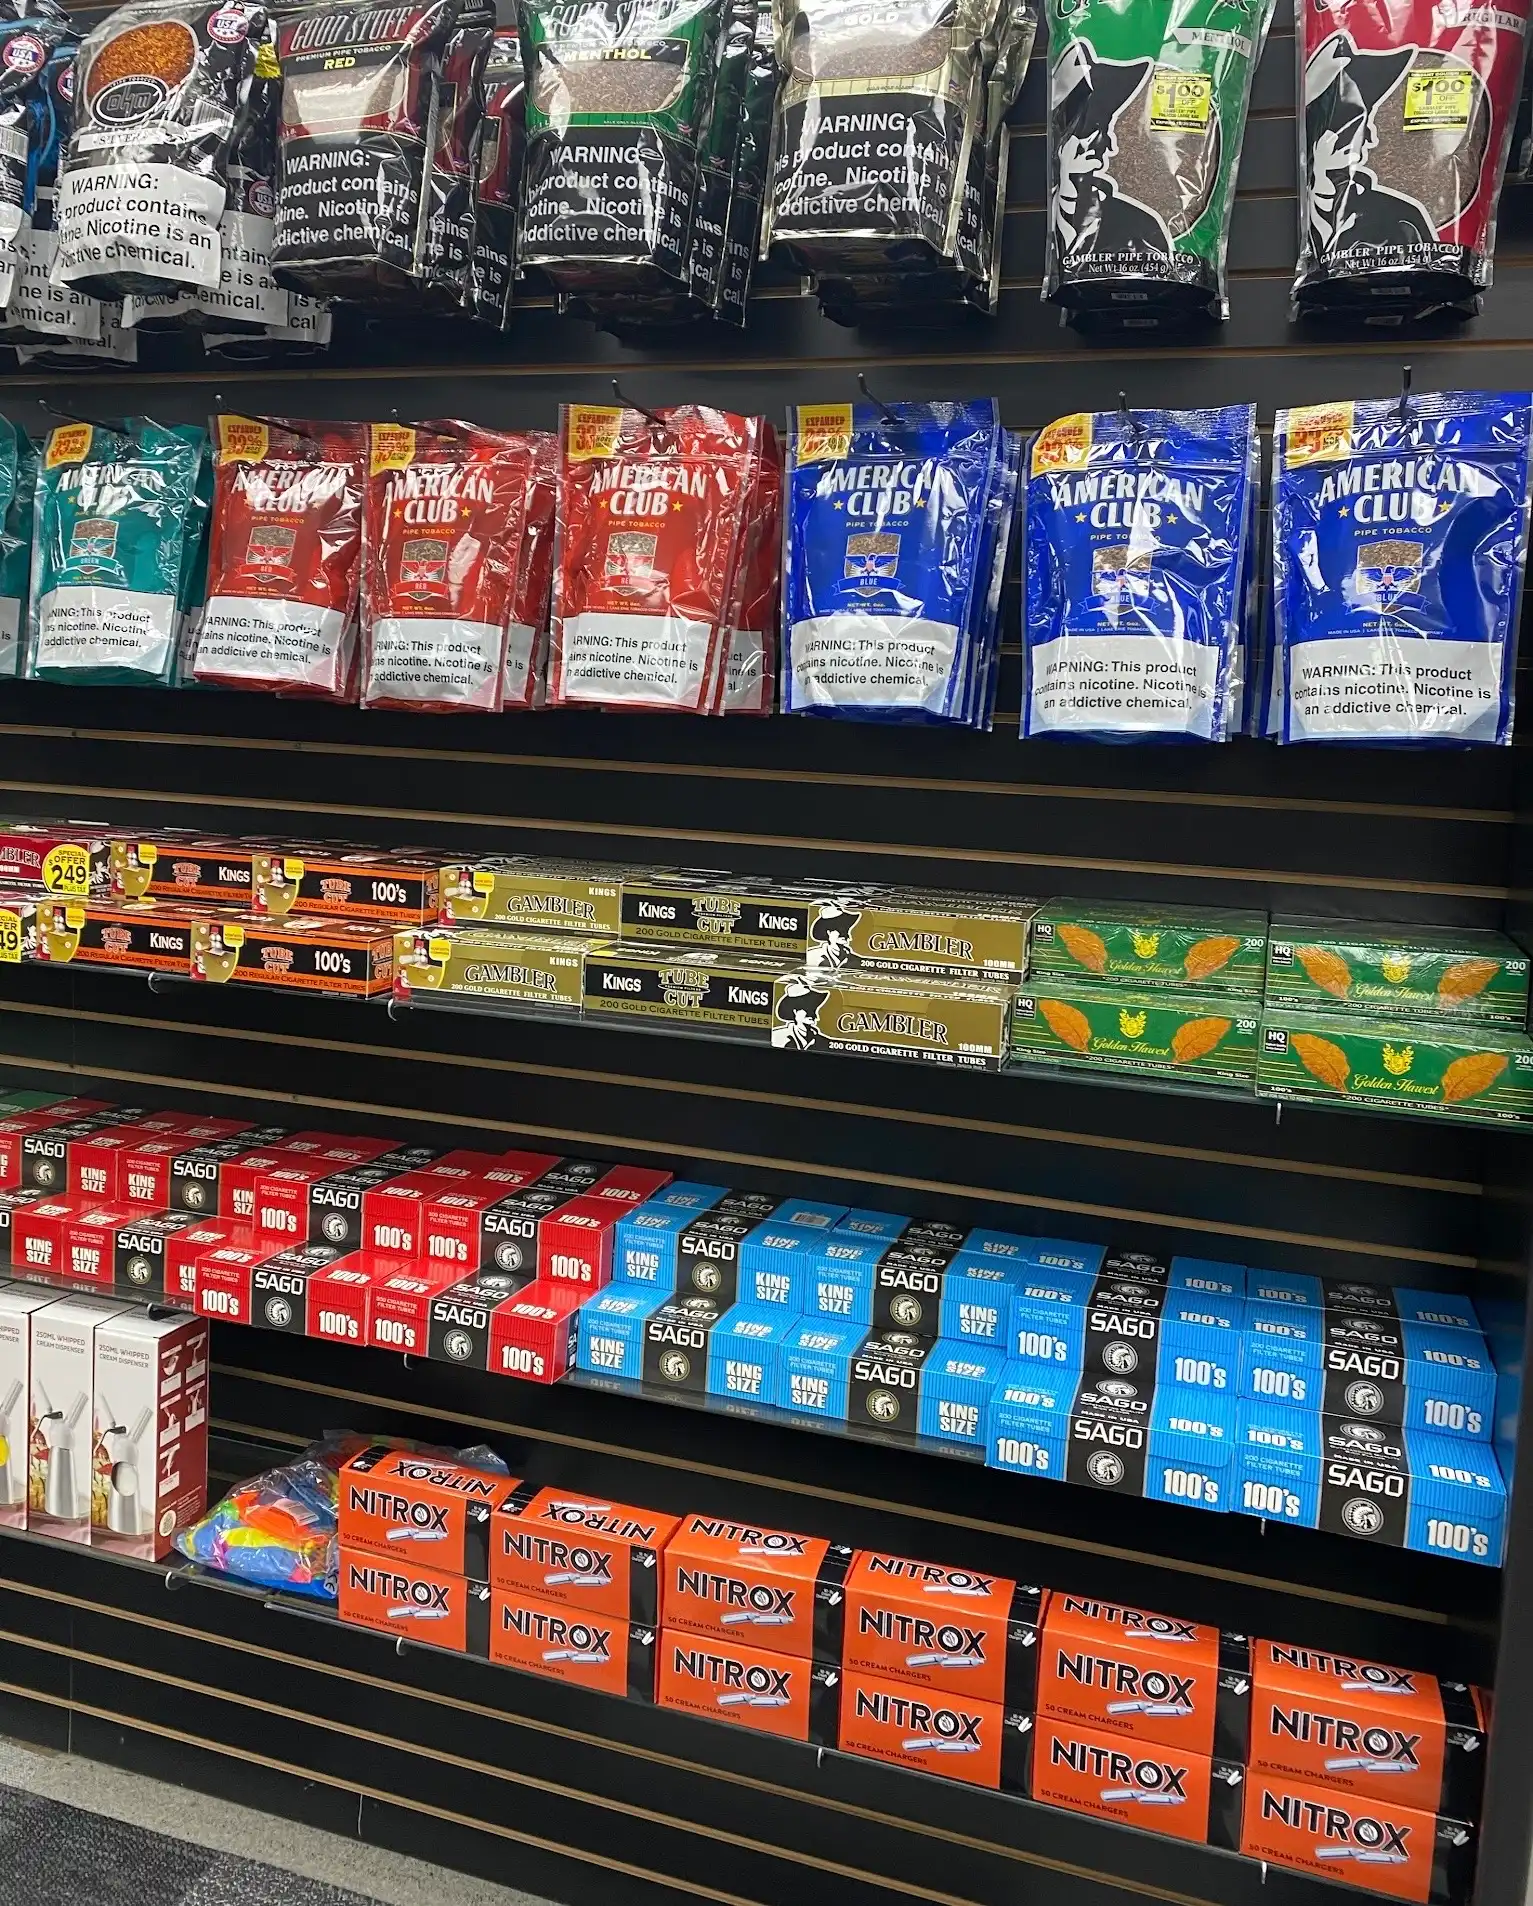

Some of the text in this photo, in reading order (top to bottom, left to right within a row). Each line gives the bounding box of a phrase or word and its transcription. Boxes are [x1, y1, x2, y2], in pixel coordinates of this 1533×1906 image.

[215, 18, 239, 30] USA
[290, 6, 413, 53] GOOD STUFF
[295, 44, 392, 62] PREMIUM PIPE TOBACCO
[564, 48, 652, 61] MENTHOL
[323, 56, 356, 70] RED
[286, 149, 371, 175] WARNING:
[792, 141, 870, 169] product
[71, 174, 159, 195] WARNING:
[281, 177, 418, 205] product contains
[539, 173, 608, 193] product
[845, 167, 947, 198] Nicotine is
[64, 196, 207, 225] product contains
[318, 200, 390, 217] Nicotine
[397, 208, 410, 225] is
[669, 209, 682, 228] is
[86, 219, 161, 239] Nicotine
[166, 226, 184, 241] is
[189, 232, 212, 250] an
[333, 224, 413, 252] chemical.
[105, 243, 196, 270] chemical.
[1117, 251, 1143, 263] PIPE
[1145, 251, 1194, 265] TOBACCO
[1376, 244, 1403, 255] PIPE
[1406, 242, 1461, 254] TOBACCO
[1052, 472, 1204, 511] AMERICAN
[1317, 457, 1479, 508] AMERICAN
[404, 500, 458, 524] CLUB
[608, 490, 669, 516] CLUB
[422, 528, 456, 536] TOBACCO
[608, 520, 665, 528] PIPE TOBACCO
[1354, 526, 1432, 536] PIPE TOBACCO
[860, 577, 878, 586] BLUE
[252, 618, 274, 631] This
[226, 632, 271, 645] nicotine.
[412, 640, 434, 652] This
[615, 637, 687, 653] This product
[859, 640, 884, 651] This
[388, 657, 432, 668] nicotine.
[589, 652, 698, 671] nicotine. Nicotine is
[830, 655, 882, 668] nicotine.
[1111, 660, 1141, 673] This
[423, 671, 474, 685] chemical.
[575, 666, 678, 684] addictive chemical.
[815, 672, 929, 686] addictive chemical.
[1302, 664, 1472, 682] WARNING: product
[1079, 678, 1139, 690] nicotine.
[1345, 683, 1491, 699] nicotine. Nicotine is
[1044, 695, 1122, 709] an addictive
[1305, 702, 1319, 715] an
[54, 855, 85, 865] OFFER
[59, 849, 86, 858] SPECIAL
[320, 878, 352, 892] TUBE
[371, 881, 407, 904] 100's
[588, 887, 617, 897] KINGS
[323, 892, 349, 904] CUT
[507, 894, 596, 921] GAMBLER
[692, 896, 741, 915] TUBE
[309, 902, 339, 911] REGULAR
[340, 904, 374, 915] CIGARETTE
[376, 908, 398, 917] FILTER
[638, 901, 676, 920] KINGS
[507, 914, 524, 922] GOLD
[525, 916, 561, 926] CIGARETTE
[563, 920, 586, 928] FILTER
[590, 922, 611, 930] TUBES
[697, 917, 735, 934] CUT
[1037, 925, 1052, 933] HQ
[150, 932, 184, 951] KINGS
[635, 927, 798, 949] 200 GOLD CIGARETTE FILTER TUBES
[314, 950, 351, 973] 100's
[983, 958, 1015, 969] 100MM
[1505, 961, 1526, 971] 200
[464, 963, 557, 993] GAMBLER
[1018, 999, 1033, 1008] HQ
[837, 1012, 949, 1045] GAMBLER
[1236, 1019, 1256, 1030] 200
[1091, 1036, 1128, 1053] Golden
[1267, 1031, 1286, 1041] HQ
[1351, 1073, 1393, 1090] Golden
[24, 1138, 65, 1159] SAGO
[80, 1166, 107, 1181] KING
[173, 1159, 217, 1181] SAGO
[81, 1179, 105, 1194] SIZE
[311, 1187, 359, 1210] SAGO
[260, 1207, 297, 1233] 100's
[484, 1214, 535, 1239] SAGO
[681, 1236, 735, 1261] SAGO
[551, 1254, 592, 1282] 100's
[626, 1250, 659, 1267] KING
[626, 1263, 657, 1281] SIZE
[880, 1268, 939, 1294] SAGO
[201, 1288, 239, 1316] 100's
[433, 1303, 487, 1329] SAGO
[959, 1303, 998, 1323] KING
[648, 1321, 705, 1349] SAGO
[960, 1318, 995, 1338] SIZE
[36, 1340, 85, 1354] CREAM DISPENSER
[57, 1336, 85, 1346] WHIPPED
[501, 1345, 544, 1376] 100's
[1328, 1350, 1400, 1380] SAGO
[791, 1374, 829, 1395] KING
[1252, 1367, 1306, 1402] 100's
[791, 1391, 826, 1409] SIZE
[1424, 1398, 1482, 1434] 100's
[1074, 1419, 1143, 1450] SAGO
[1163, 1467, 1219, 1503] 100's
[349, 1484, 450, 1533] NITROX
[690, 1518, 811, 1554] NITROX
[1427, 1518, 1489, 1557] 100's
[677, 1566, 796, 1619] NITROX
[502, 1604, 611, 1658] NITROX
[859, 1605, 988, 1660] NITROX
[1057, 1706, 1087, 1718] CREAM
[1088, 1714, 1134, 1731] CHARGERS
[1270, 1704, 1423, 1767] NITROX
[1050, 1735, 1189, 1799] NITROX
[1270, 1762, 1303, 1775] CREAM
[1304, 1770, 1354, 1787] CHARGERS
[1262, 1789, 1412, 1858] NITROX
